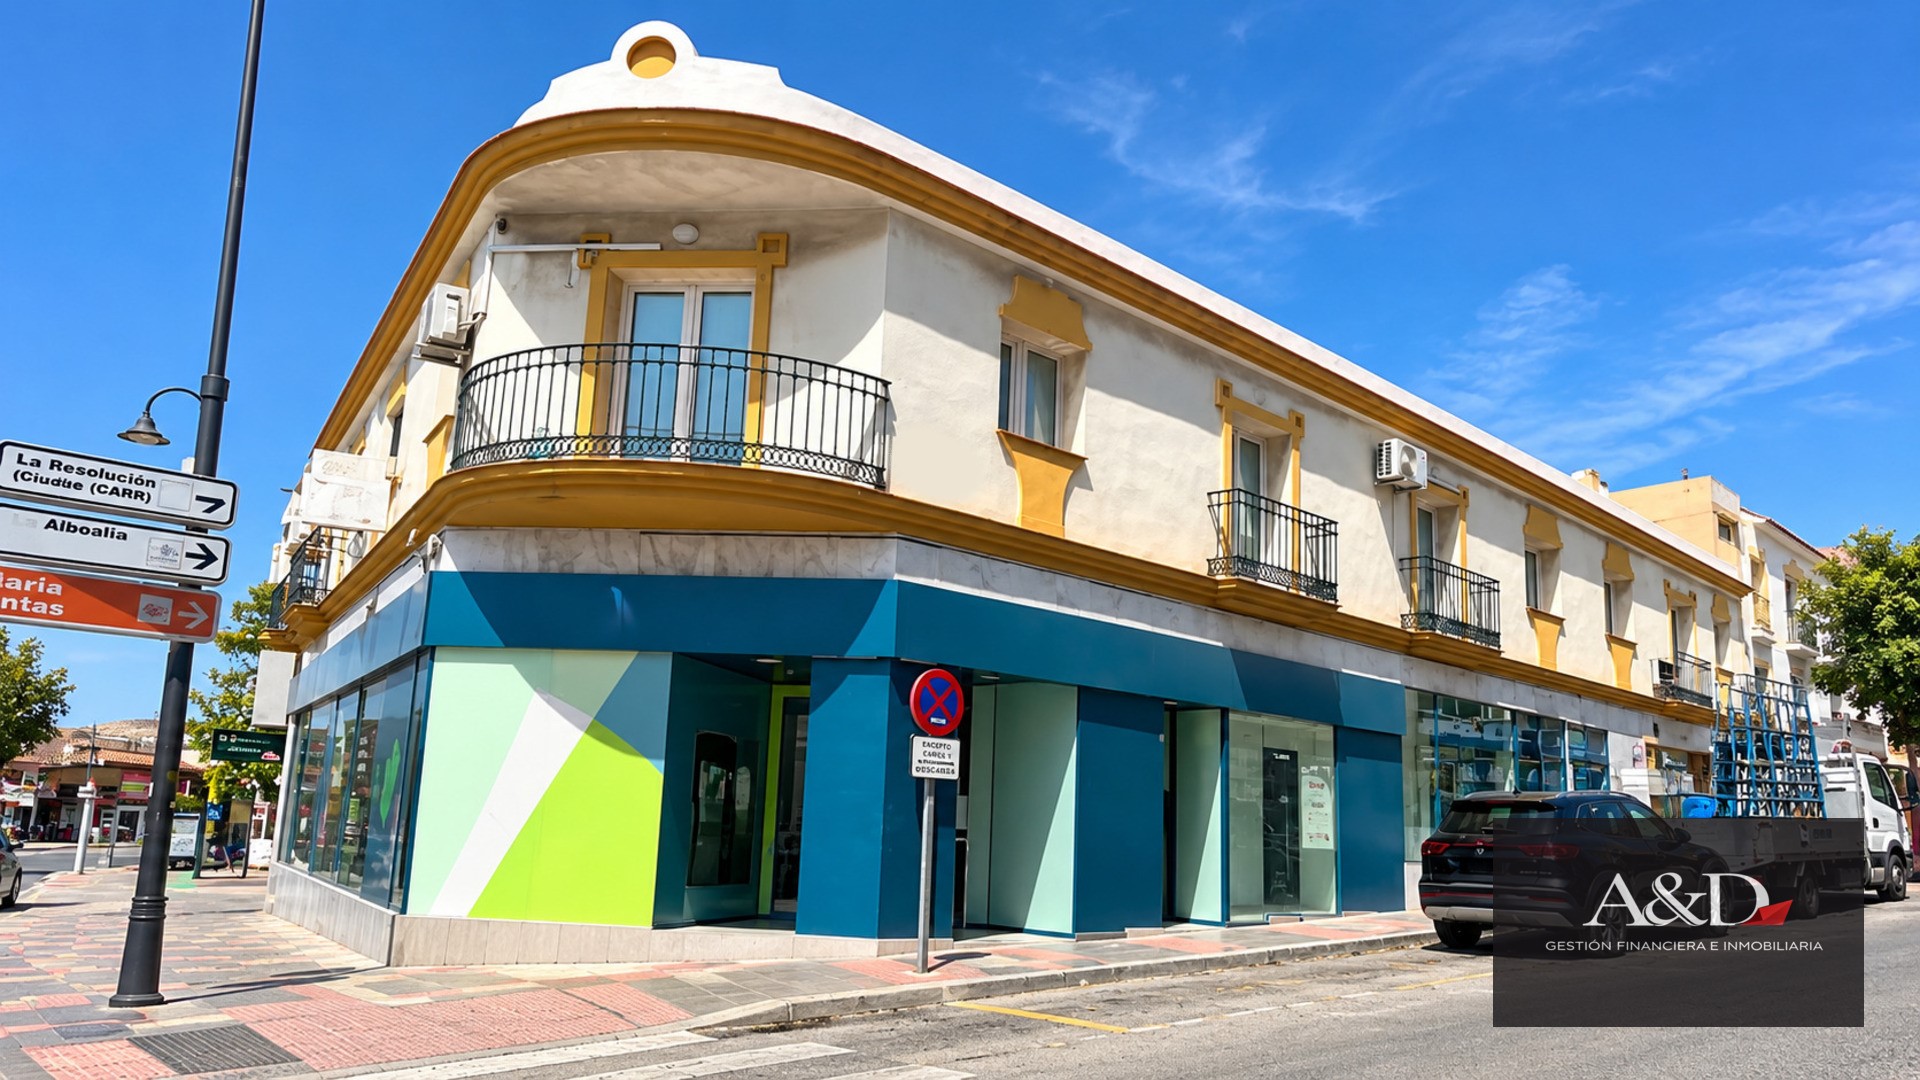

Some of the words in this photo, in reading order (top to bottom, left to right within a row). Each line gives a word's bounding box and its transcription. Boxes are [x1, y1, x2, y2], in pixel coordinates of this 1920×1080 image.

[16, 453, 42, 468] La
[48, 459, 156, 489] Resolución
[90, 482, 152, 504] (CARR)
[44, 518, 128, 541] Alboalia
